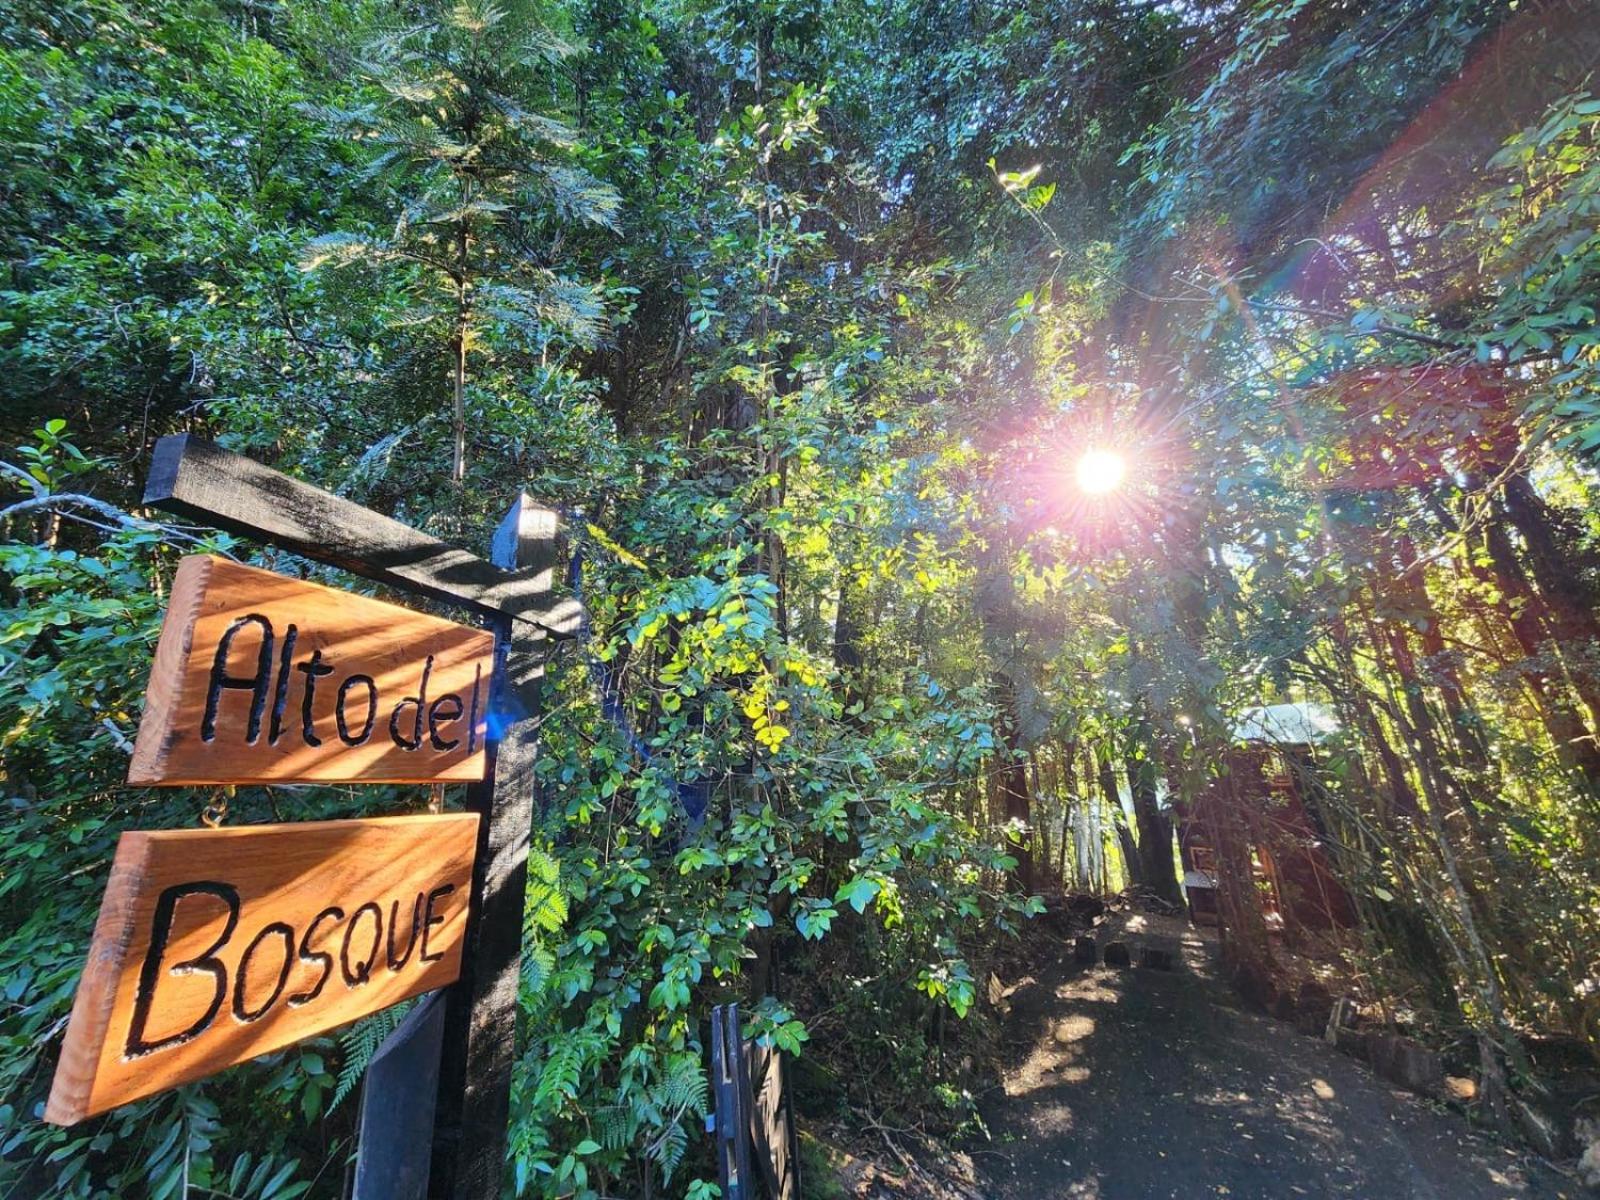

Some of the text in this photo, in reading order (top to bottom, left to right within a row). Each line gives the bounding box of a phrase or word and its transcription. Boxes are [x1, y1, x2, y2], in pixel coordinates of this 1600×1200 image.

[201, 613, 482, 755] Alto del
[121, 880, 455, 1062] BOSQUE
